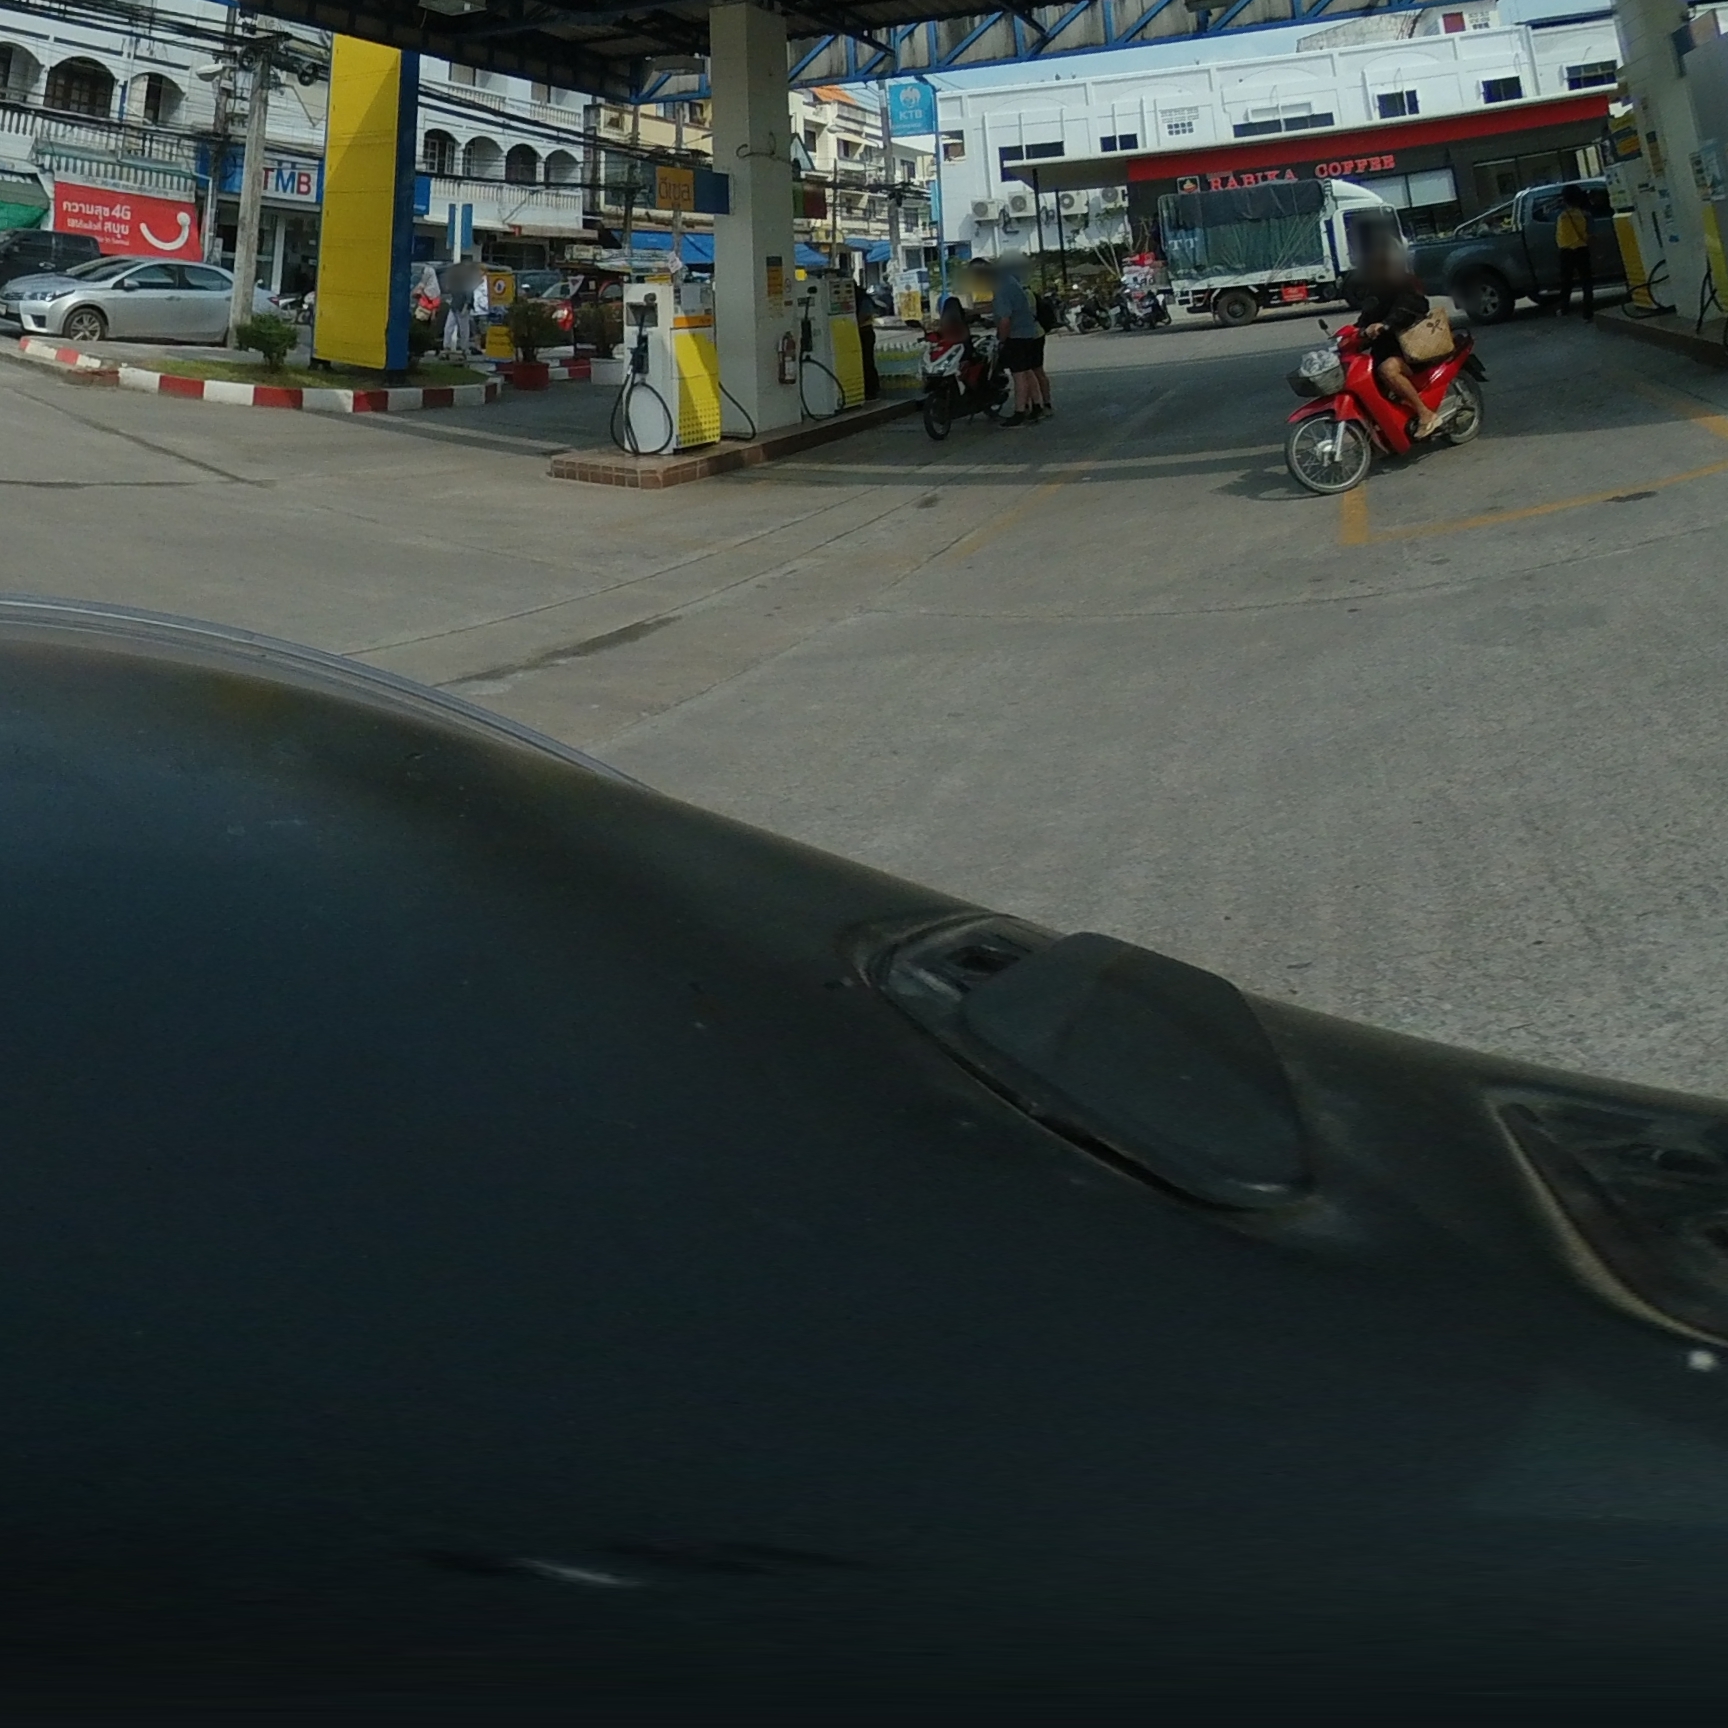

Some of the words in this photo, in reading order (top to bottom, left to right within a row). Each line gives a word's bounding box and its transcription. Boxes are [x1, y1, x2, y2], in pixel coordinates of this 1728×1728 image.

[899, 109, 923, 121] KTB
[263, 167, 311, 196] TMB
[1207, 169, 1298, 191] RABIKA
[1315, 154, 1395, 178] COFFEE
[111, 203, 132, 220] 4G
